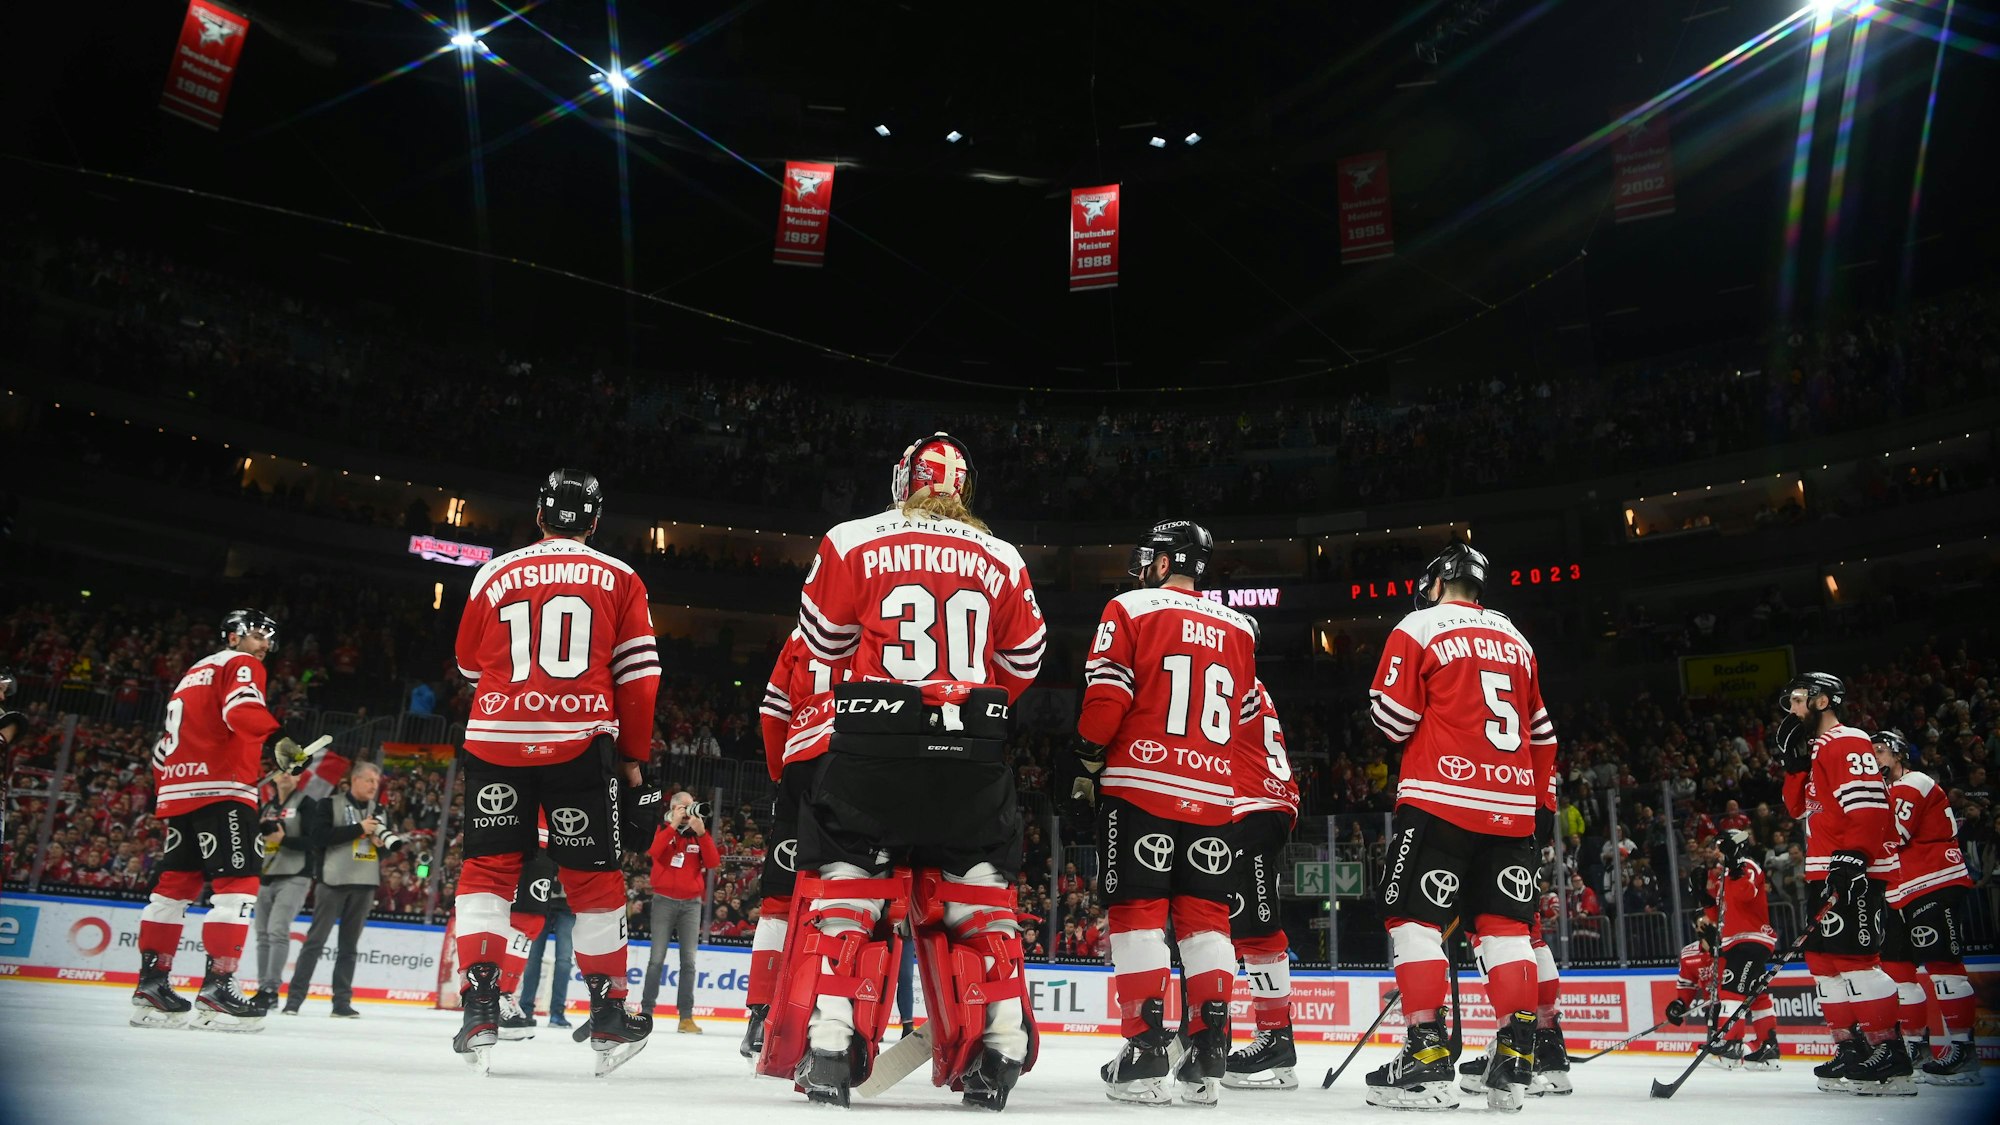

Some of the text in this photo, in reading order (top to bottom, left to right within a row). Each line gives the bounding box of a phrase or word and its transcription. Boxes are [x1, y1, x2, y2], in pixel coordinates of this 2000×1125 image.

[176, 77, 220, 103] 1986
[1621, 176, 1665, 196] 2002
[784, 204, 827, 215] Deutscher
[786, 216, 820, 227] Meister
[784, 231, 819, 244] 1987
[1073, 229, 1116, 239] Deutscher
[1078, 242, 1111, 251] Meister
[1077, 255, 1111, 268] 1988
[546, 497, 555, 507] 10
[584, 503, 592, 513] 10
[1153, 520, 1190, 533] STETSON
[1175, 553, 1186, 562] 16
[862, 543, 1006, 600] PANTKOWSKI
[1510, 564, 1582, 586] 2023
[485, 563, 615, 608] MATSUMOTO
[1228, 588, 1280, 607] NOW
[499, 594, 592, 684] 10
[880, 584, 991, 685] 30
[1093, 620, 1116, 654] 16
[1181, 618, 1226, 653] BAST
[1430, 636, 1473, 666] VAN
[236, 665, 252, 683] 9
[1383, 655, 1402, 687] 5
[1713, 661, 1760, 676] Radio
[1720, 677, 1756, 693] Köln
[514, 691, 609, 713] TOYOTA
[835, 698, 905, 714] CCM
[1162, 654, 1235, 746] 16
[1479, 670, 1522, 752] 5
[1846, 752, 1880, 776] 39
[228, 809, 241, 852] TOYOTA
[473, 815, 520, 829] TOYOTA
[611, 802, 622, 860] TOYOTA
[552, 833, 596, 847] TOYOTA
[1108, 809, 1118, 868] TOYOTA
[1391, 827, 1416, 881] TOYOTA
[1254, 854, 1267, 902] TOYOTA
[1314, 987, 1336, 997] Haie
[1590, 994, 1621, 1004] HAIE!
